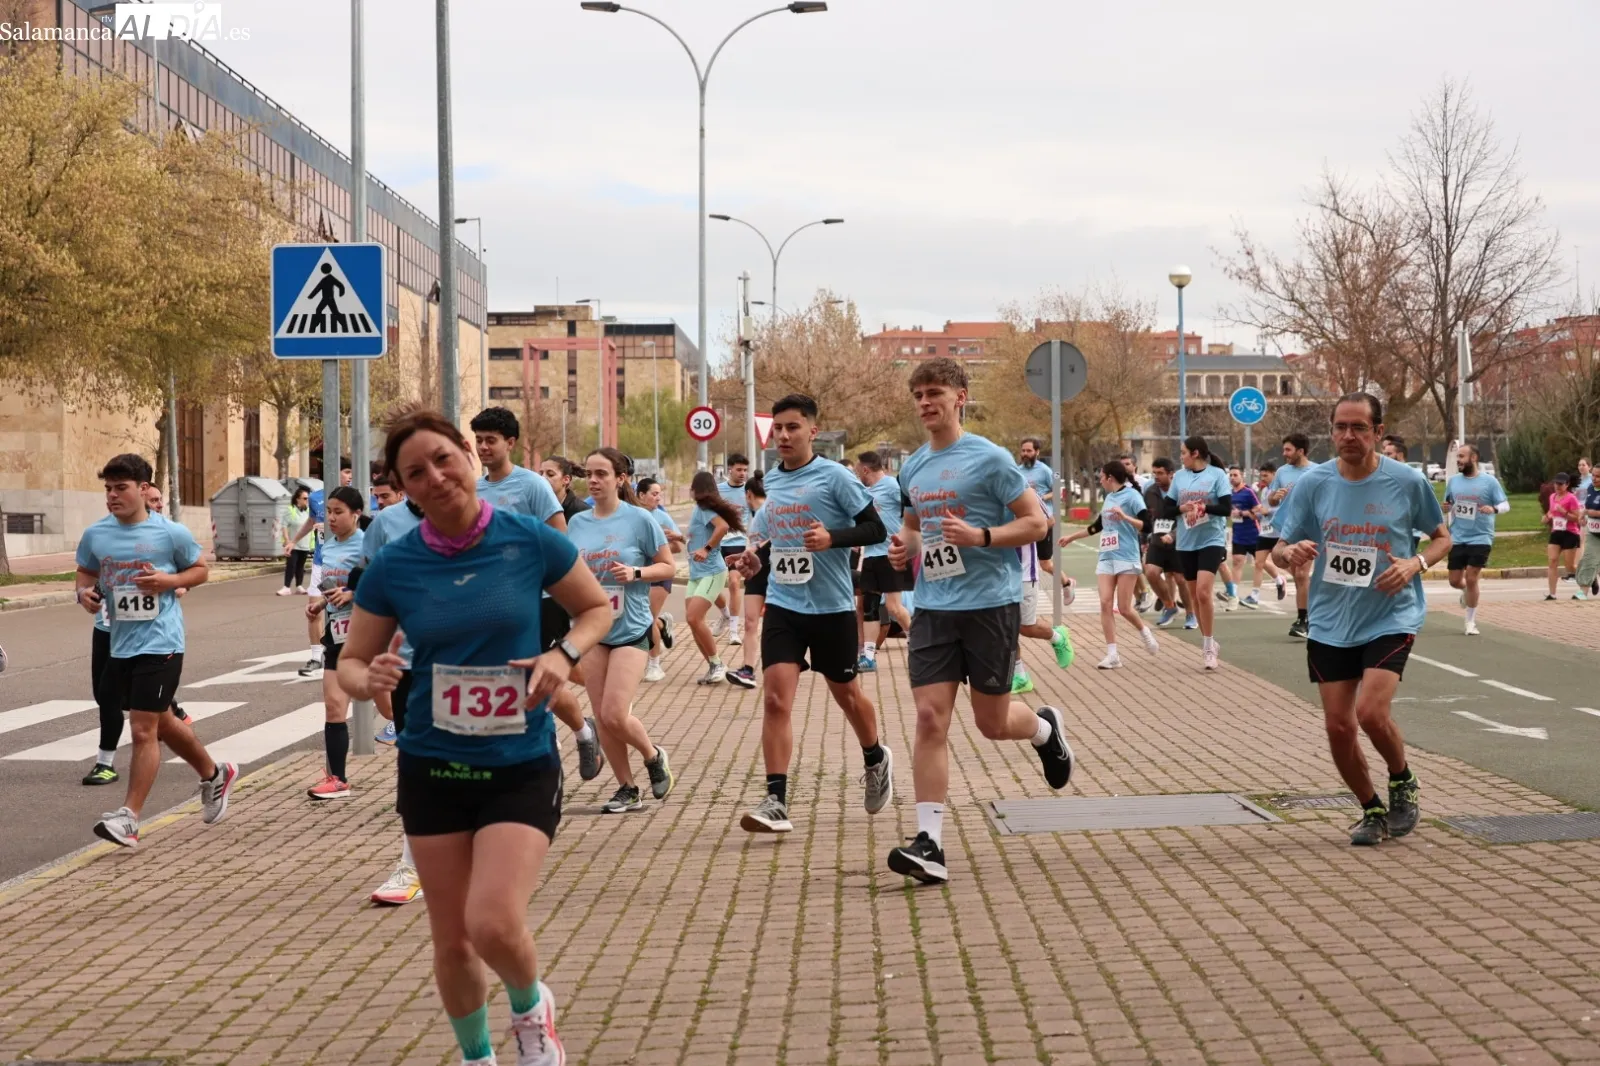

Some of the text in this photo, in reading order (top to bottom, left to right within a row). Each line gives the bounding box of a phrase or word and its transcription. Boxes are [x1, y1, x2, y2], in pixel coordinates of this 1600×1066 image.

[693, 418, 712, 430] 30
[1456, 504, 1474, 516] 331
[1101, 536, 1117, 547] 238
[924, 545, 958, 569] 413
[1329, 554, 1372, 576] 408
[776, 557, 810, 574] 412
[117, 595, 155, 611] 418
[333, 619, 350, 635] 17
[442, 684, 518, 717] 132
[430, 768, 492, 780] HANKER
